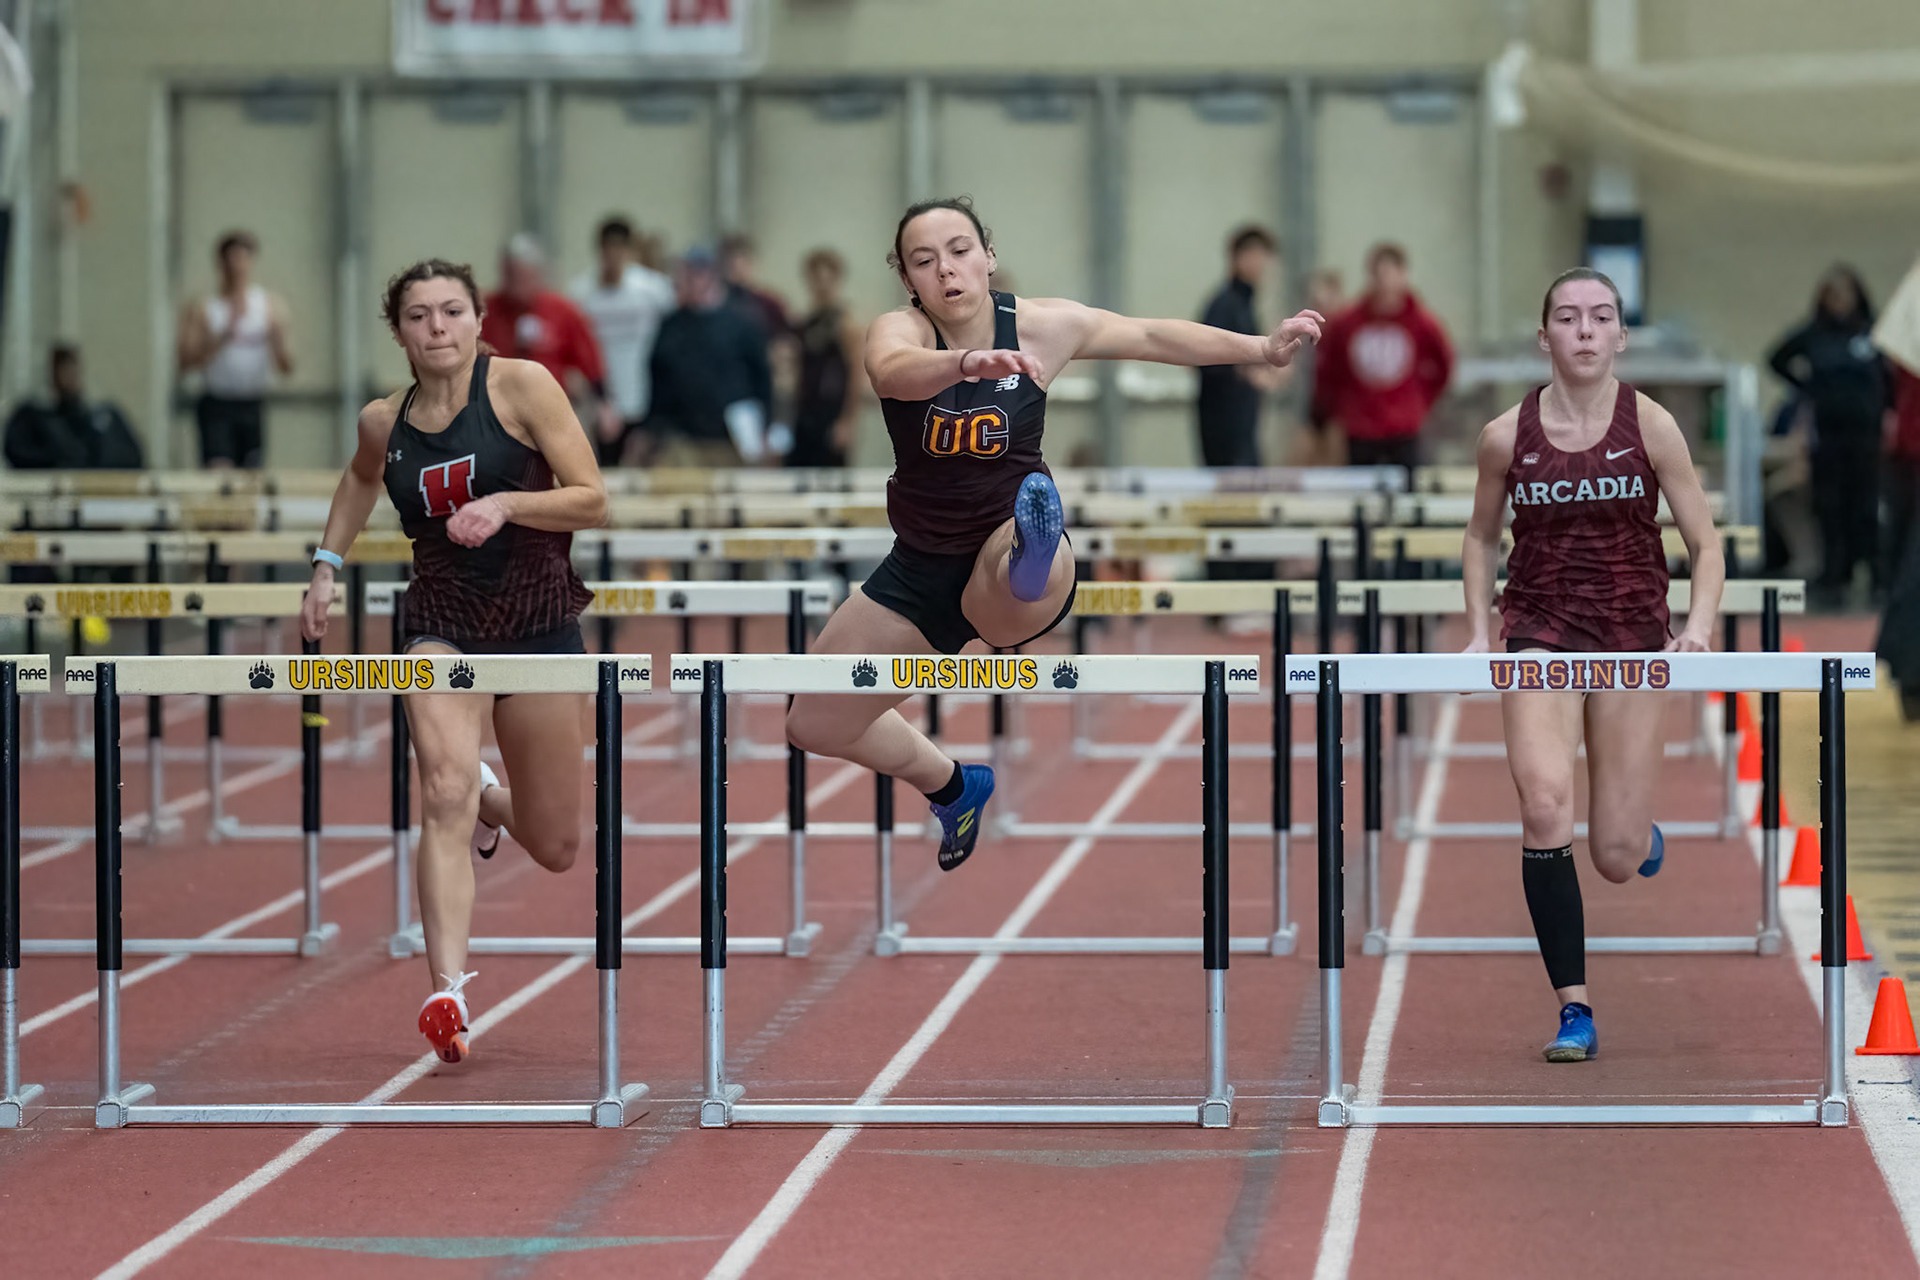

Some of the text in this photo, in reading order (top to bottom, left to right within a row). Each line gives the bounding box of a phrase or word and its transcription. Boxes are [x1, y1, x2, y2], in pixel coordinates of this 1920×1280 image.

[925, 406, 1007, 457] UC
[419, 453, 476, 518] H
[1514, 475, 1645, 505] ARCADIA
[288, 659, 434, 690] URSINUS
[891, 658, 1038, 689] URSINUS
[1490, 659, 1670, 689] URSINUS
